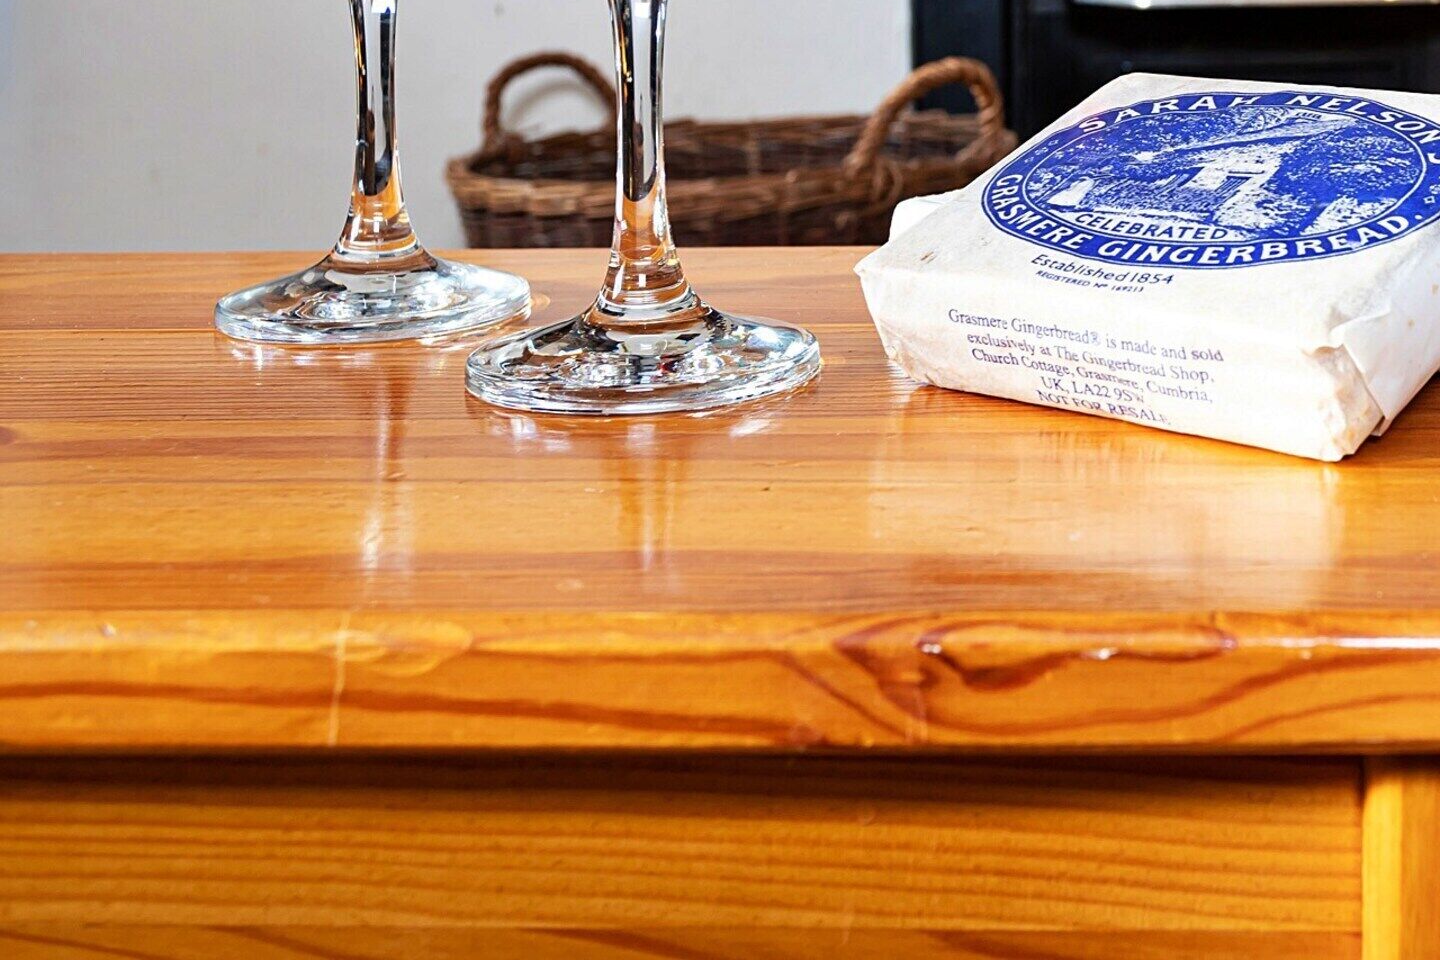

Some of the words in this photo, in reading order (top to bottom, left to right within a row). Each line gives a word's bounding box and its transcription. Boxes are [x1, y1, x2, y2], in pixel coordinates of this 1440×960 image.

[992, 174, 1093, 250] GRASMERE
[1074, 213, 1228, 240] CELEBRATED
[1030, 252, 1131, 282] Established
[1130, 272, 1175, 285] 1854
[1035, 270, 1091, 287] REGISTERED
[948, 308, 1008, 330] Grasmere
[1106, 333, 1117, 349] is
[1120, 339, 1157, 356] made
[1161, 346, 1187, 360] and
[1191, 348, 1224, 362] sold
[966, 333, 1036, 356] exclusively
[1040, 345, 1053, 357] at
[1054, 345, 1080, 362] The
[1082, 350, 1166, 378] Gingerbread
[971, 348, 1019, 366] Church
[1021, 355, 1075, 377] Cottage,
[1036, 389, 1070, 406] NOT
[1072, 381, 1111, 399] LA22
